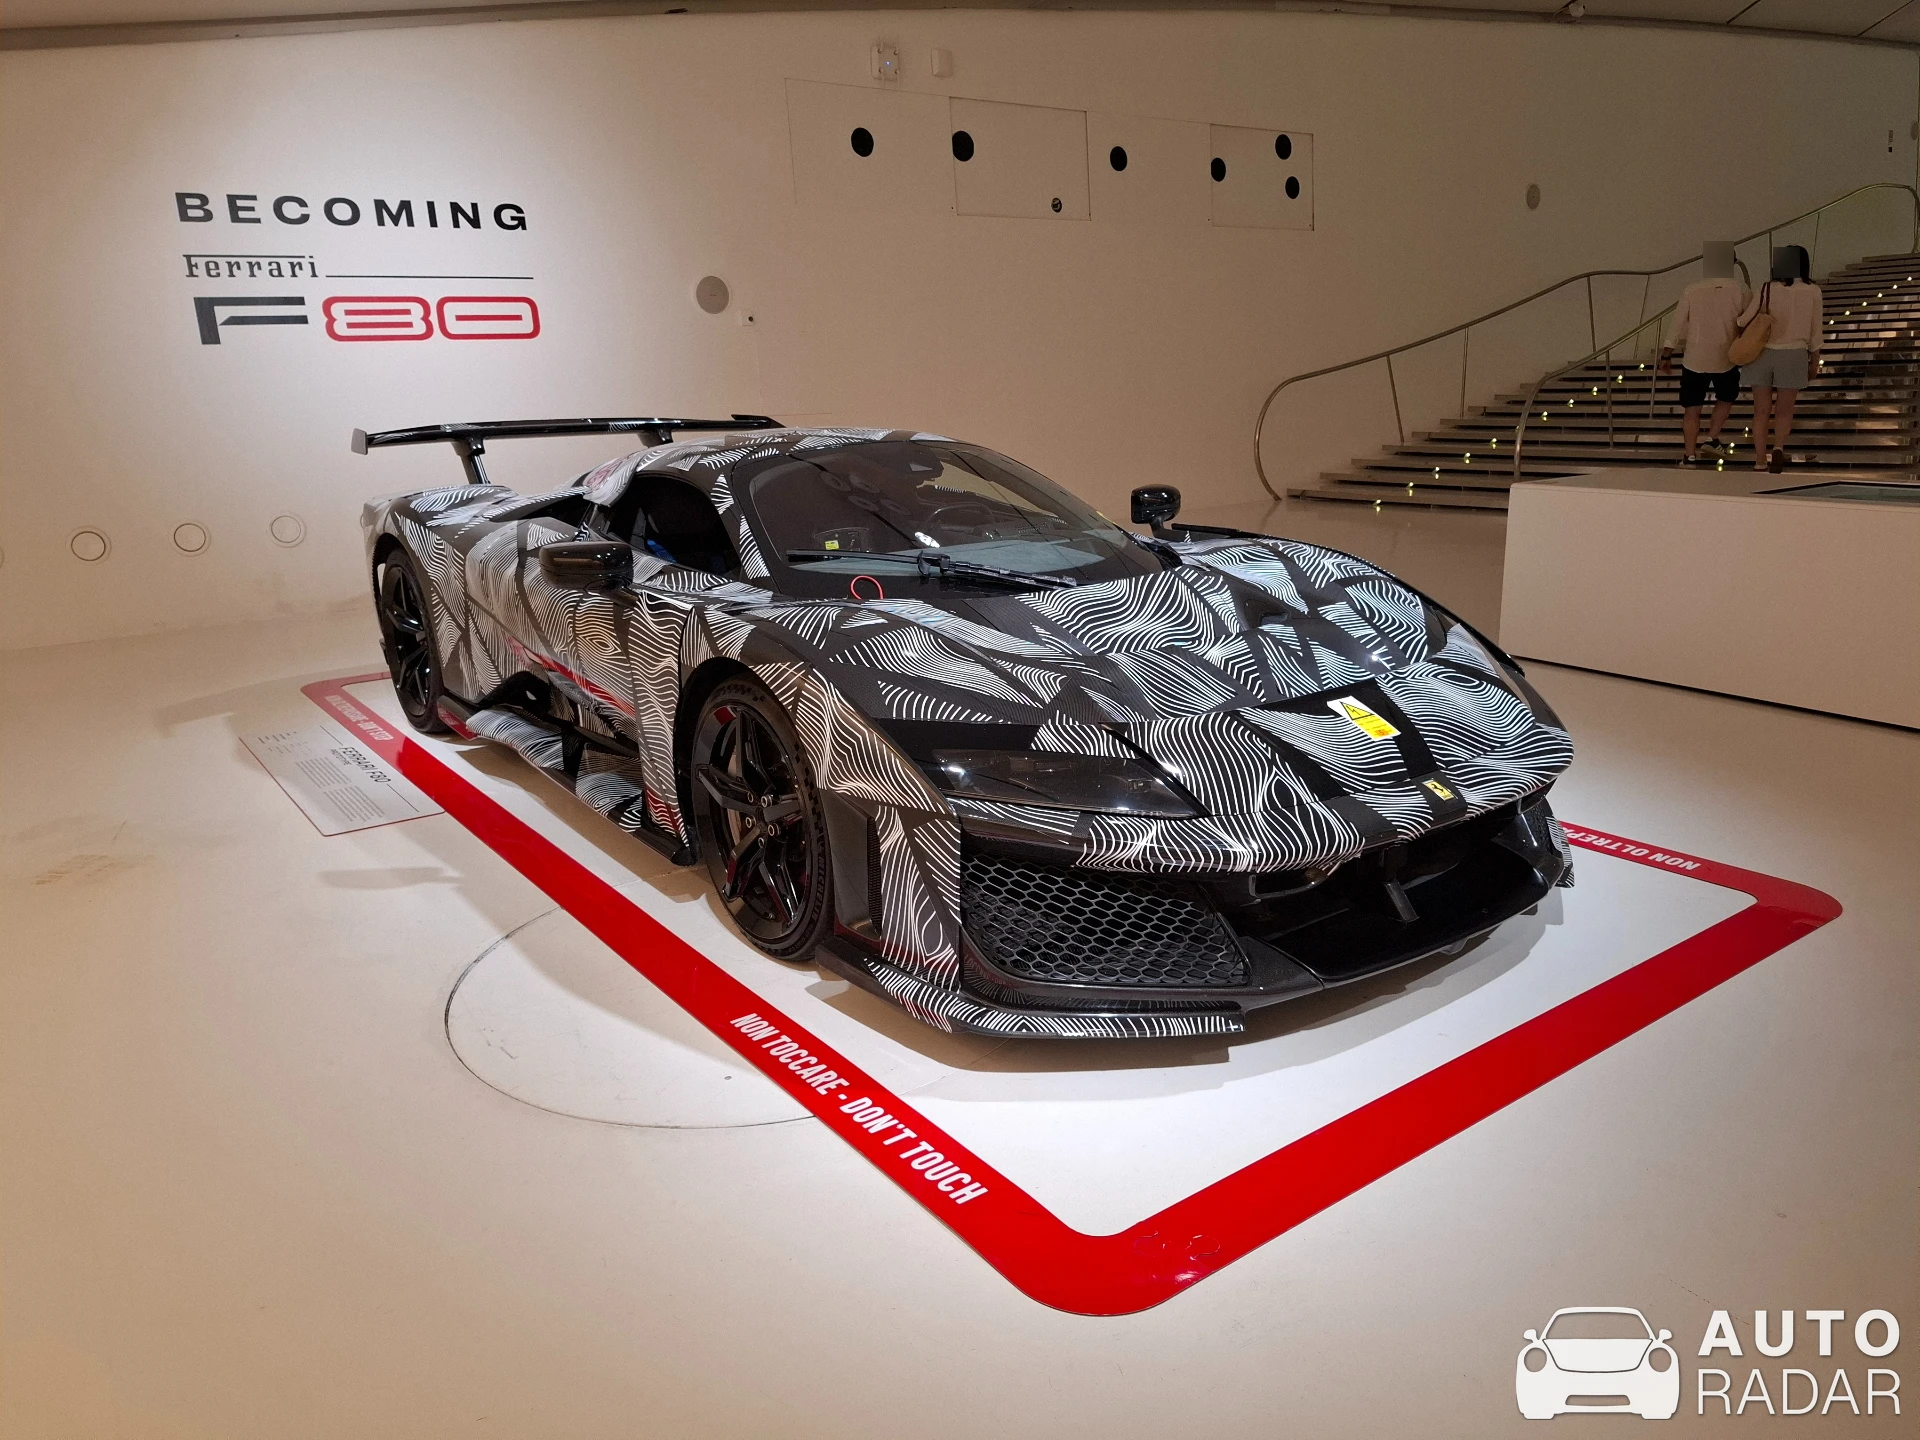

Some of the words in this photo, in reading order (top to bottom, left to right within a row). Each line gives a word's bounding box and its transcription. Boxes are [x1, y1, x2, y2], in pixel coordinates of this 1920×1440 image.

[175, 192, 527, 231] BECOMING
[182, 254, 318, 278] Ferrari
[193, 296, 541, 345] F80
[339, 747, 378, 771] FERRARI
[1648, 852, 1701, 871] NON
[812, 856, 825, 920] MICHELIN
[730, 1013, 780, 1042] NON
[761, 1035, 850, 1095] TOCCARE
[839, 1097, 918, 1146] DON'T
[899, 1141, 988, 1205] TOUCH
